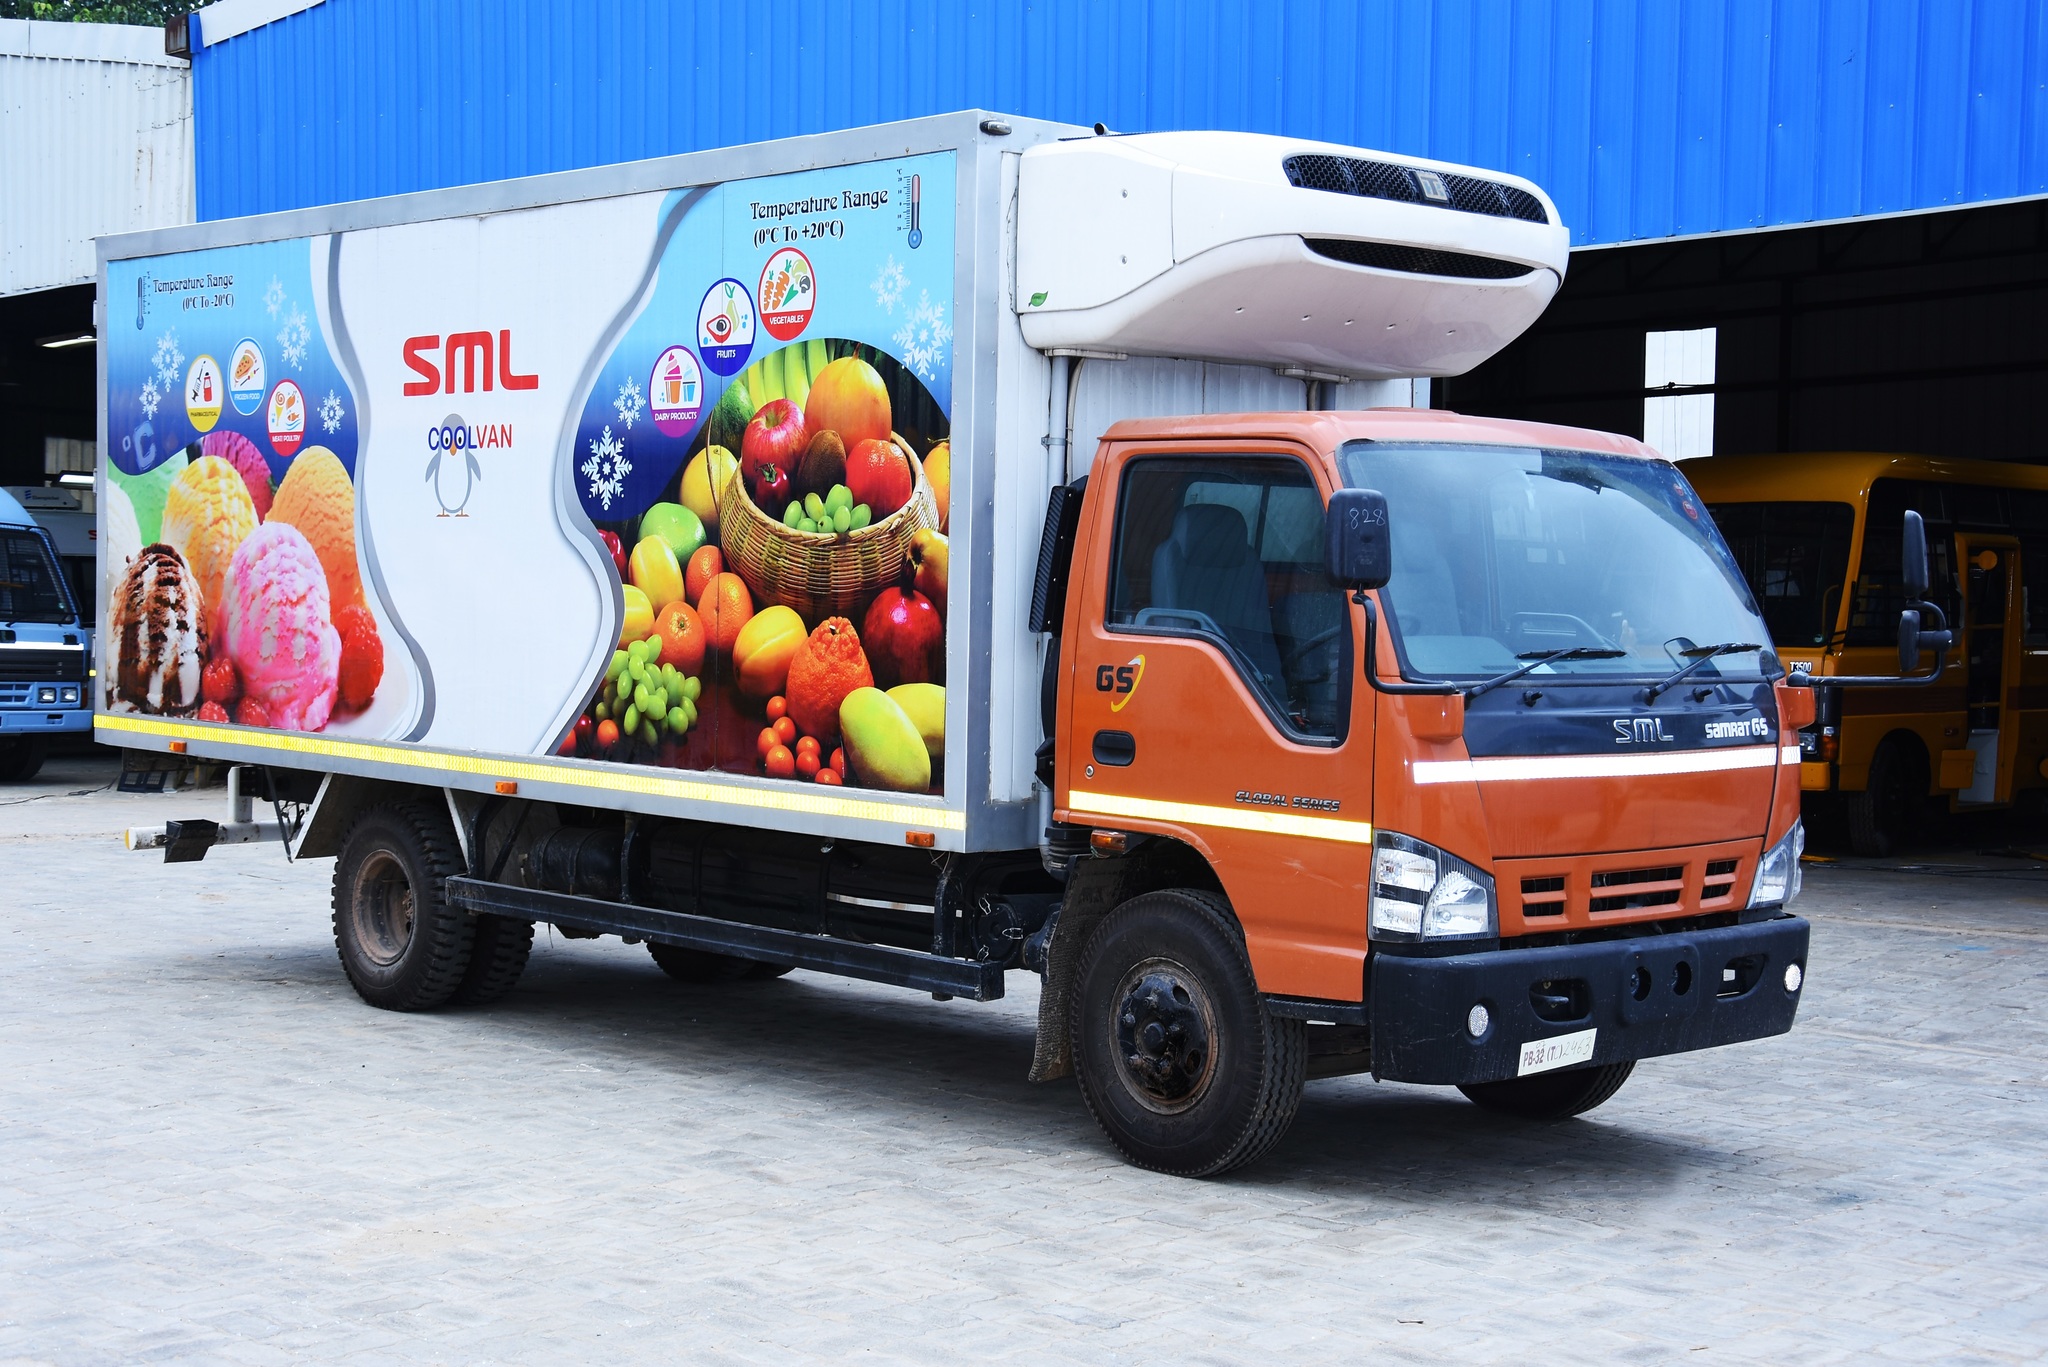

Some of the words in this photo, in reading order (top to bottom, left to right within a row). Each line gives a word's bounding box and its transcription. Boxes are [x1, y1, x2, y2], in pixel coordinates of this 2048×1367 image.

[750, 195, 838, 221] Temperature
[842, 190, 888, 211] Range
[783, 226, 798, 242] To
[153, 278, 205, 295] Temperature
[206, 274, 233, 290] Range
[200, 296, 210, 309] To
[769, 315, 804, 325] VEGETABLES
[403, 329, 539, 397] SML
[716, 350, 736, 359] FRUITS
[654, 412, 670, 421] DAIRY
[671, 411, 697, 420] PRODUCTS
[1349, 507, 1386, 530] 828
[1790, 661, 1812, 673] T3500
[1096, 664, 1134, 693] GS
[1613, 717, 1674, 744] SML
[1751, 717, 1769, 736] GS
[1235, 790, 1288, 808] GLOBAL
[1291, 796, 1341, 812] SERIES
[1523, 1048, 1545, 1067] PB-32
